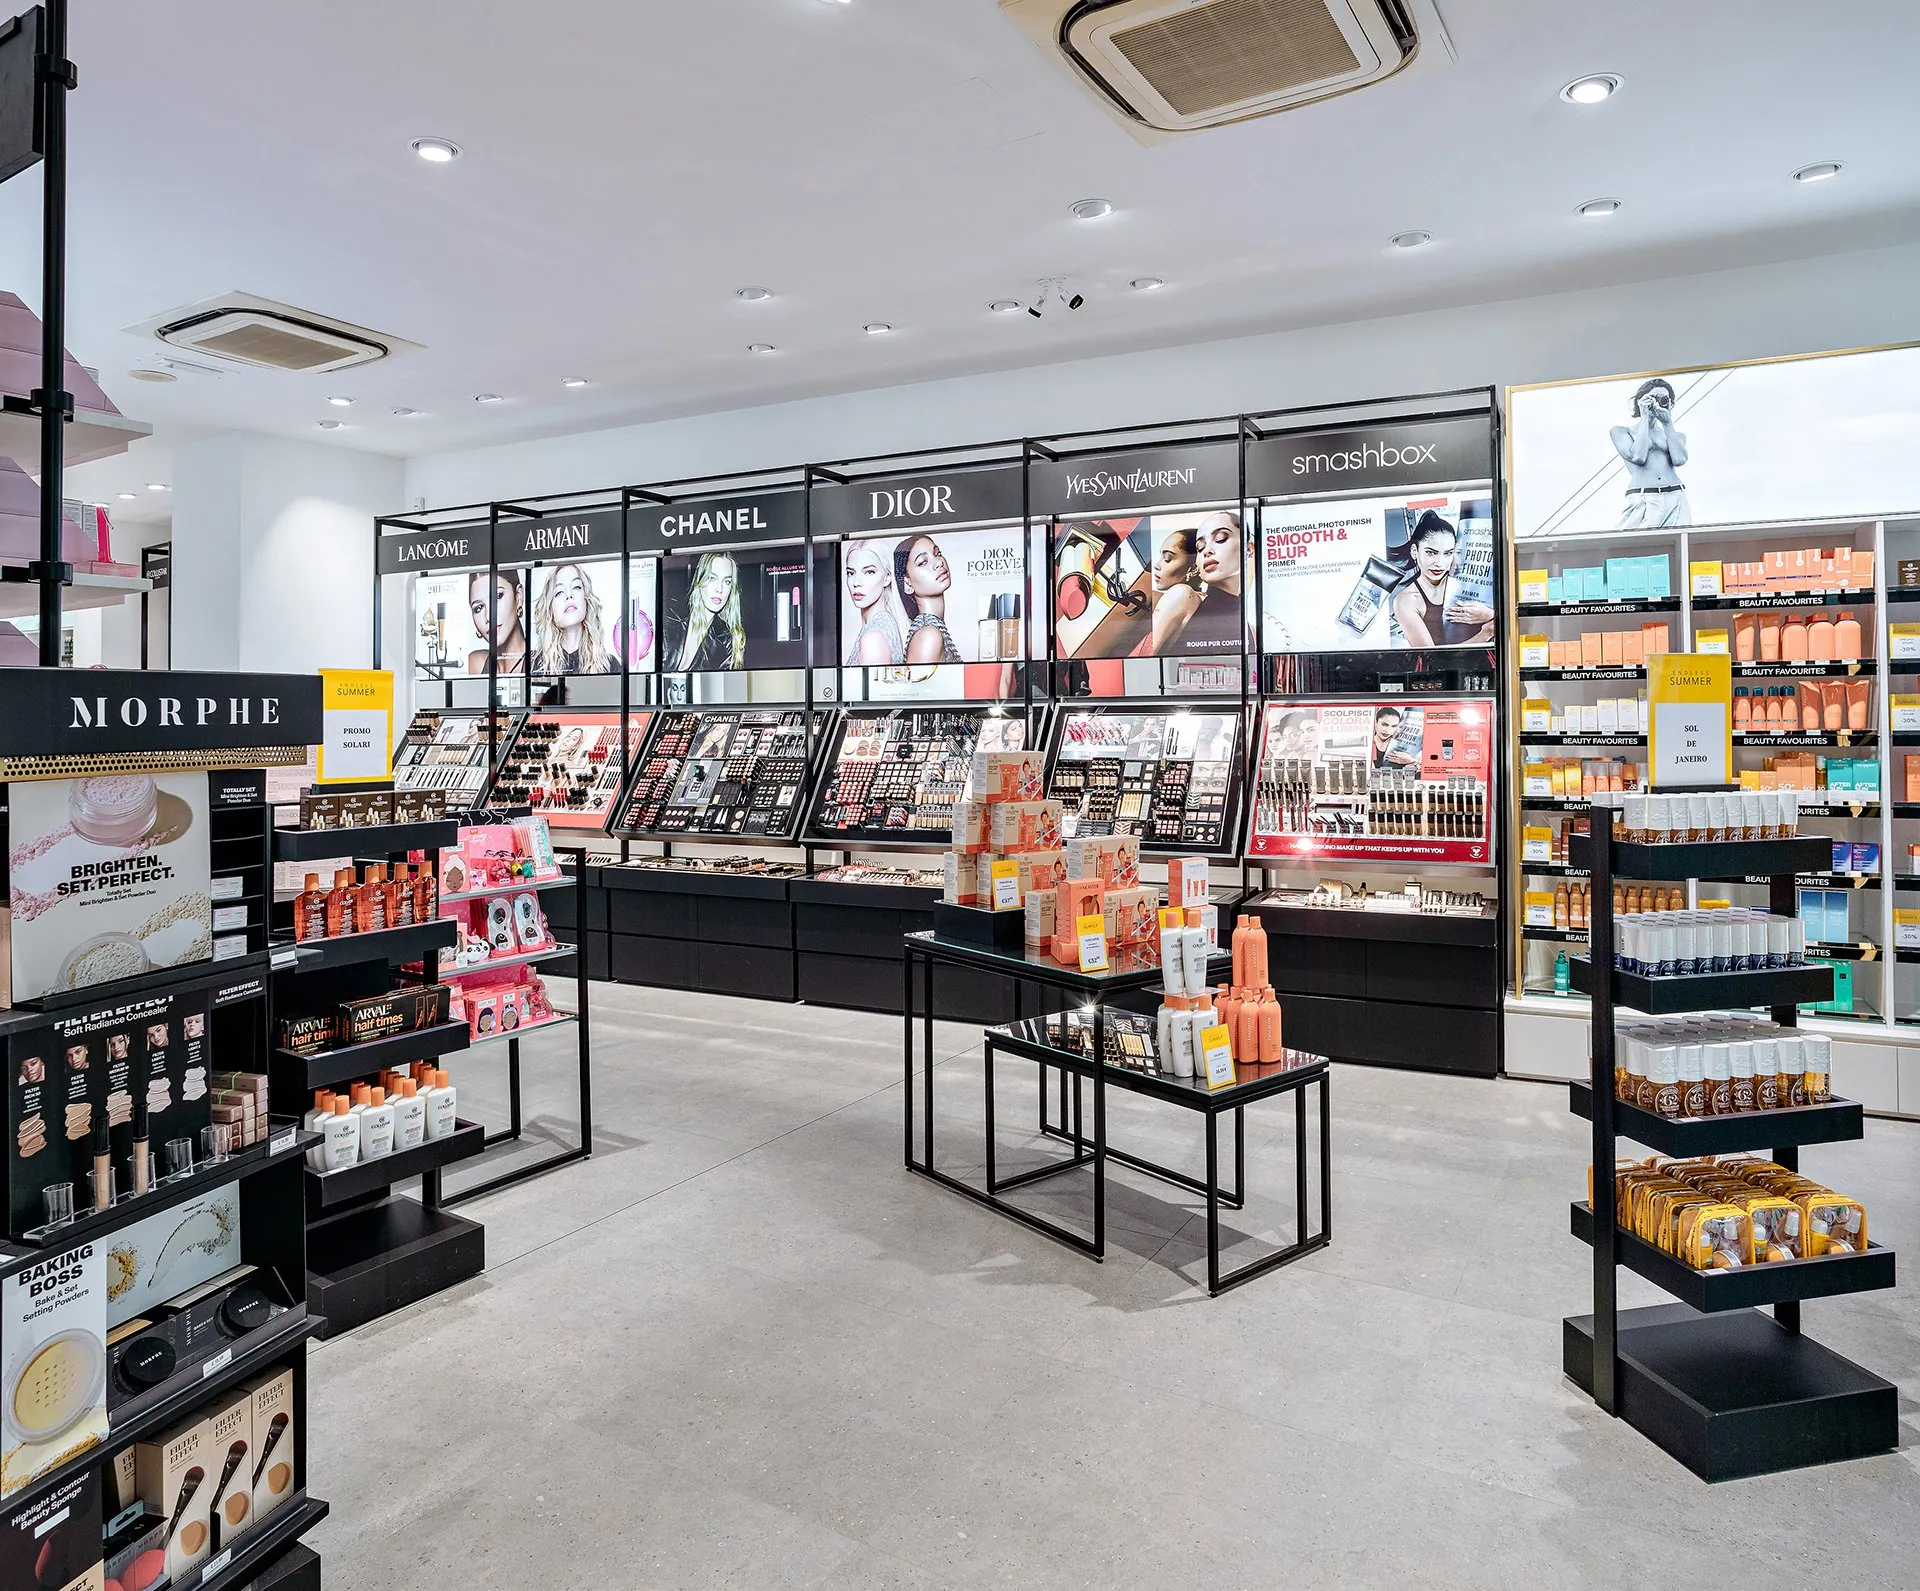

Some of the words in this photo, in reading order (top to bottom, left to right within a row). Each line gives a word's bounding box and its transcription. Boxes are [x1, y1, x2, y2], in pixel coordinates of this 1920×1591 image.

[1292, 441, 1437, 475] smashbox
[869, 485, 955, 520] DIOR
[660, 507, 767, 538] CHANEL
[1282, 523, 1317, 533] ORIGINAL
[1318, 520, 1345, 529] PHOTO
[1346, 518, 1372, 526] FINISH
[524, 524, 590, 551] ARMANI
[1266, 529, 1334, 548] SMOOTH
[1336, 528, 1348, 540] &
[398, 538, 469, 562] LANCÔME
[983, 547, 1014, 560] DIOR
[1267, 545, 1308, 560] BLUR
[1465, 550, 1493, 562] PHOTO
[1268, 560, 1296, 568] PRIMER
[1462, 563, 1490, 578] FINISH
[1560, 606, 1589, 614] BEAUTY
[1590, 605, 1636, 613] FAVOURITES
[1739, 599, 1771, 607] BEAUTY
[1773, 597, 1823, 606] FAVOURITES
[1562, 672, 1591, 680] BEAUTY
[1670, 677, 1712, 686] SUMMER
[337, 687, 376, 697] SUMMER
[68, 697, 280, 728] MORPHE
[343, 727, 371, 736] PROMO
[343, 740, 370, 748] SOLARI
[1686, 740, 1697, 748] DE
[1675, 755, 1708, 764] JANEIRO
[71, 855, 162, 879] BRIGHTEN.
[56, 878, 95, 896] SET.
[98, 866, 175, 890] PERFECT.
[92, 896, 114, 905] Brighten
[127, 891, 146, 899] Powder
[219, 986, 238, 996] FILTER
[239, 980, 260, 990] EFFECT
[63, 1026, 83, 1038] Soft
[84, 1016, 126, 1033] Radiance
[126, 1005, 169, 1022] Concealer
[354, 1018, 375, 1032] half
[376, 1012, 403, 1028] times
[356, 1005, 390, 1022] ARVAL
[292, 1018, 328, 1036] ARVAL
[292, 1033, 311, 1046] half
[18, 1244, 94, 1286] BAKING
[30, 1264, 84, 1298] BOSS
[22, 1304, 54, 1322] Setting
[54, 1288, 90, 1312] Powders
[35, 1293, 56, 1308] Bake
[57, 1290, 63, 1298] &
[64, 1284, 78, 1294] Set
[258, 1382, 283, 1402] FILTER
[258, 1388, 285, 1410] EFFECT
[215, 1408, 242, 1430] FILTER
[215, 1416, 243, 1438] EFFECT
[170, 1433, 199, 1456] FILTER
[170, 1440, 200, 1464] EFFECT
[12, 1500, 50, 1526] Highlight
[50, 1494, 57, 1502] &
[57, 1472, 90, 1497] Contour
[20, 1506, 50, 1531] Beauty
[50, 1485, 82, 1513] Sponge
